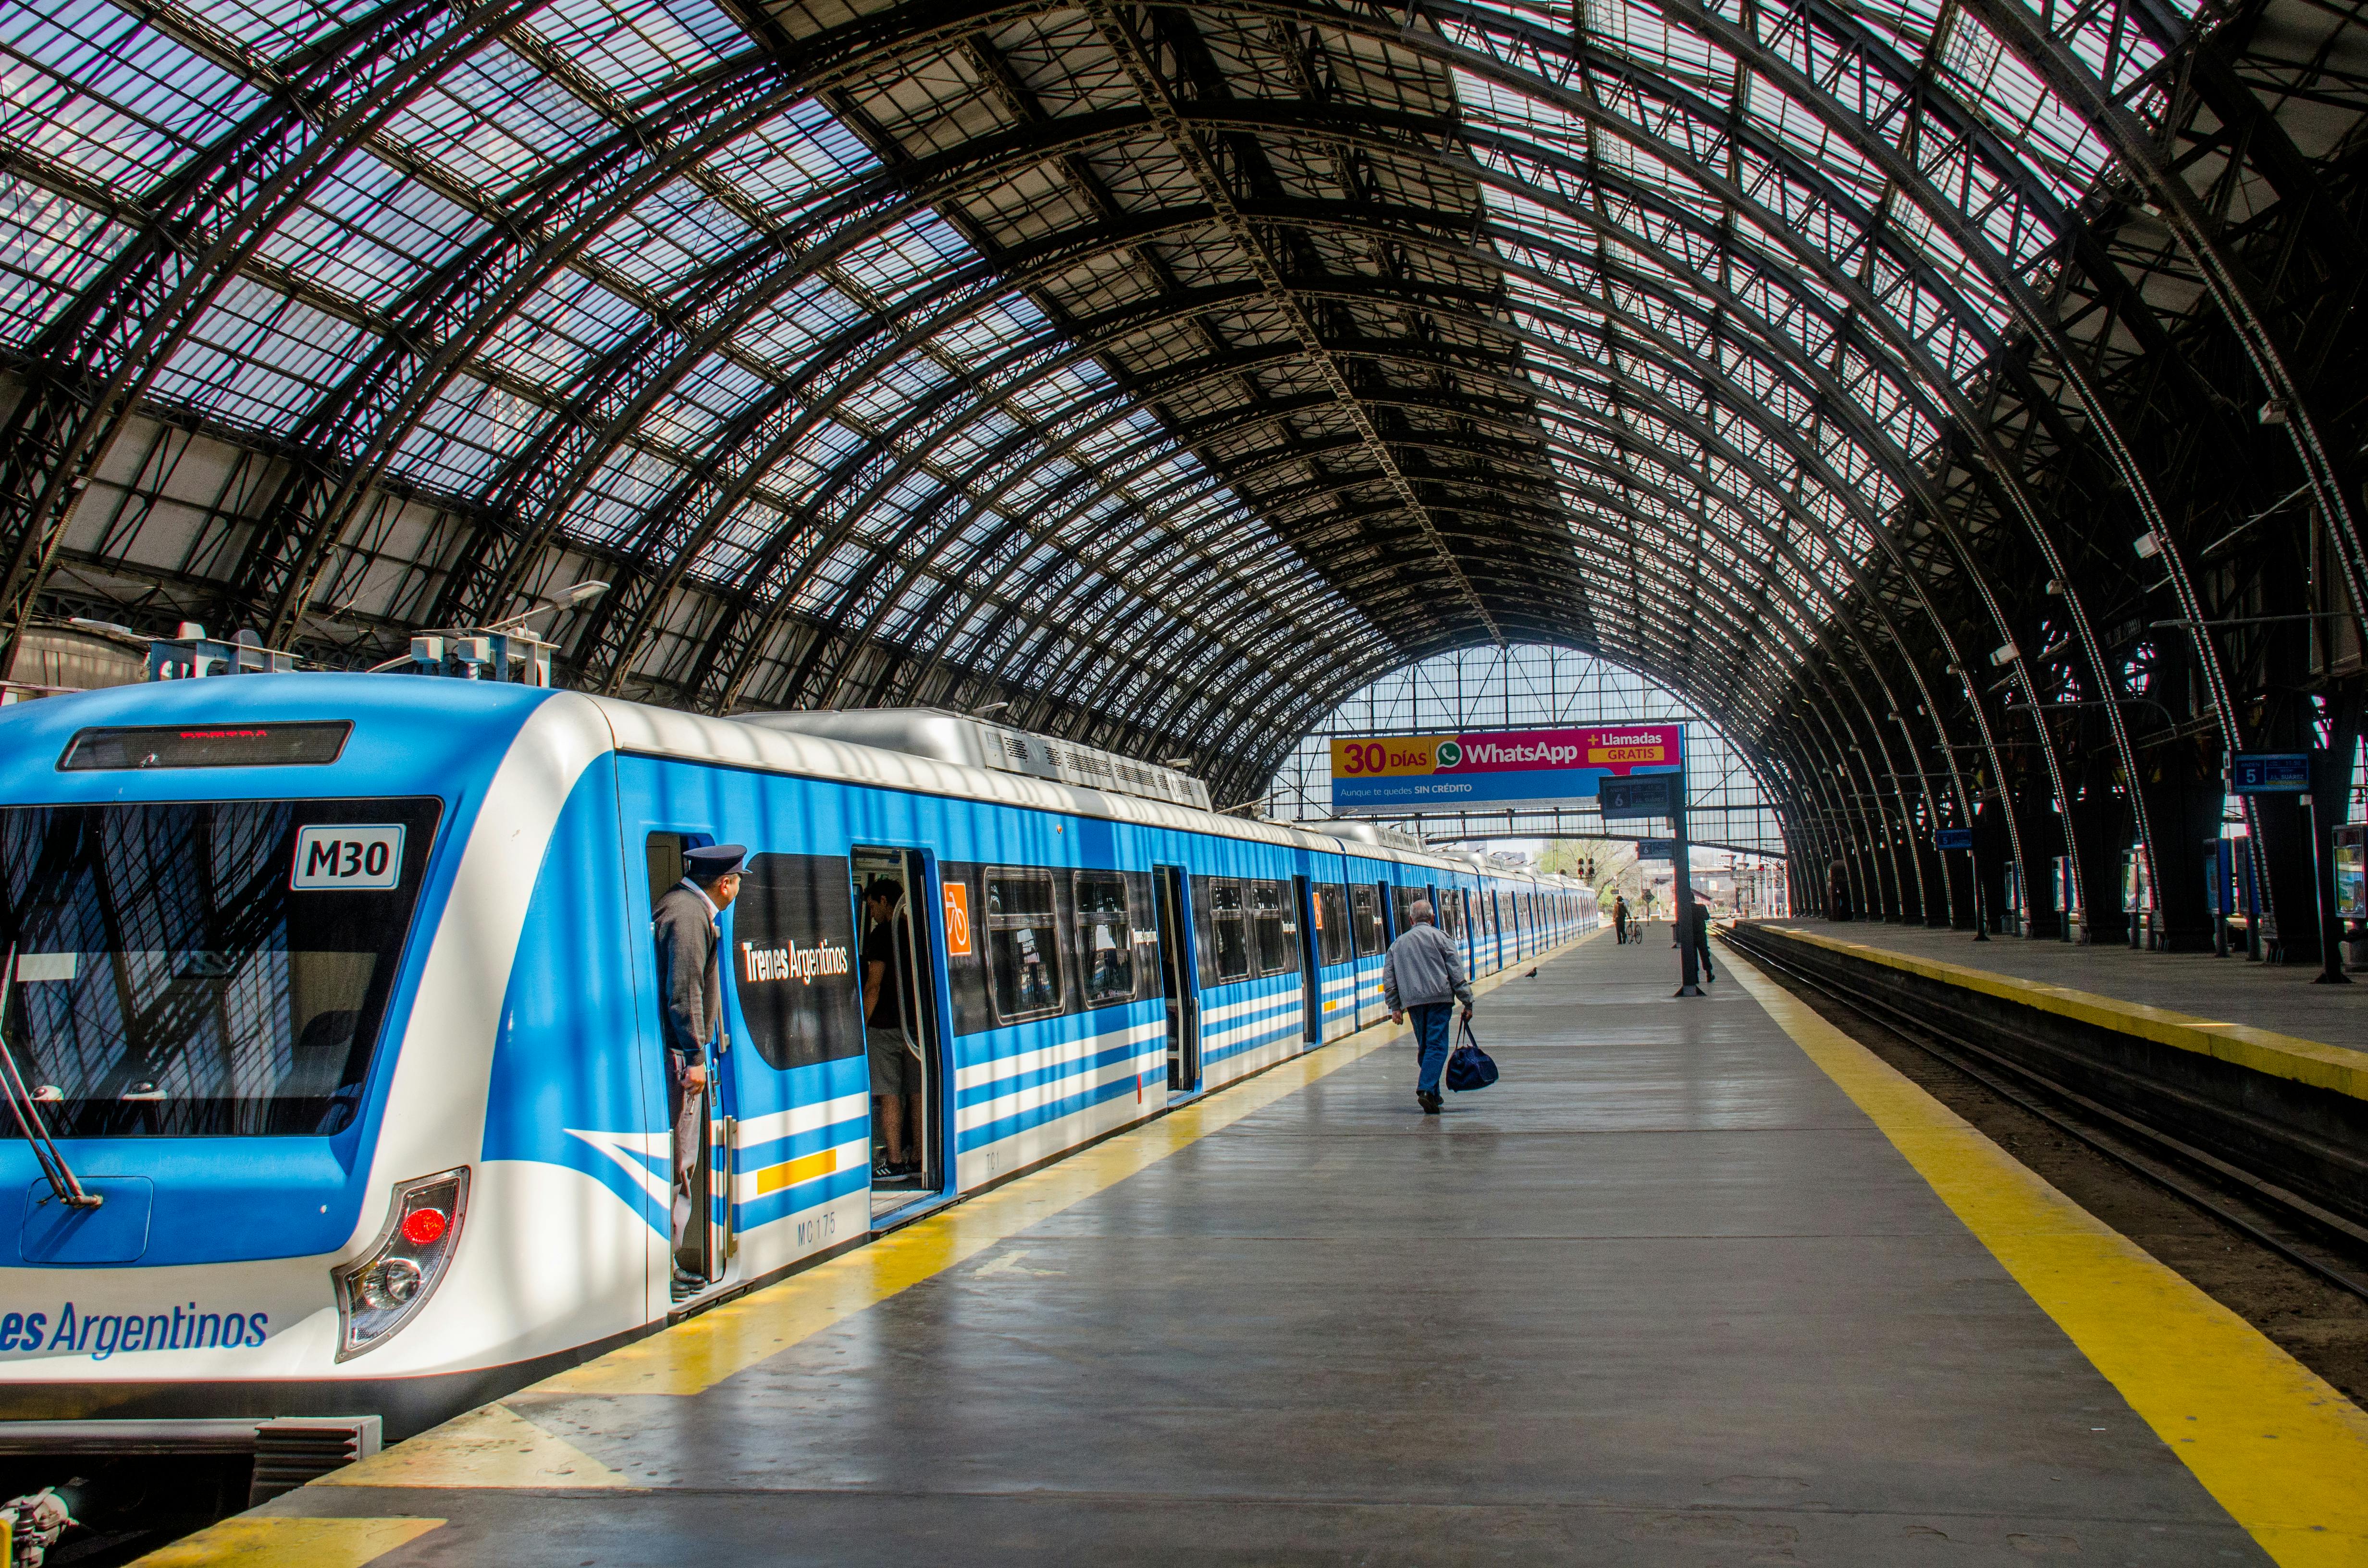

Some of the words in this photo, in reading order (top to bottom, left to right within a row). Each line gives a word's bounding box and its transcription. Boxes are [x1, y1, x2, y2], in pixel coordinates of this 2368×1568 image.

[1602, 732, 1662, 746] Llamadas
[1344, 743, 1386, 774] 30
[1391, 750, 1427, 767] DÍAS
[1465, 742, 1578, 764] WhatsApp
[1608, 748, 1654, 760] GRATIS
[2246, 769, 2256, 783] 5
[1341, 788, 1371, 797] Aunque
[1384, 787, 1412, 796] quedes
[1414, 785, 1430, 794] SIN
[1431, 783, 1472, 793] CRÉDITO
[1615, 794, 1623, 807] 6
[306, 840, 390, 878] M30
[741, 942, 789, 982] Trenes
[789, 938, 848, 986] Argentinos
[47, 1301, 269, 1361] Argentinos
